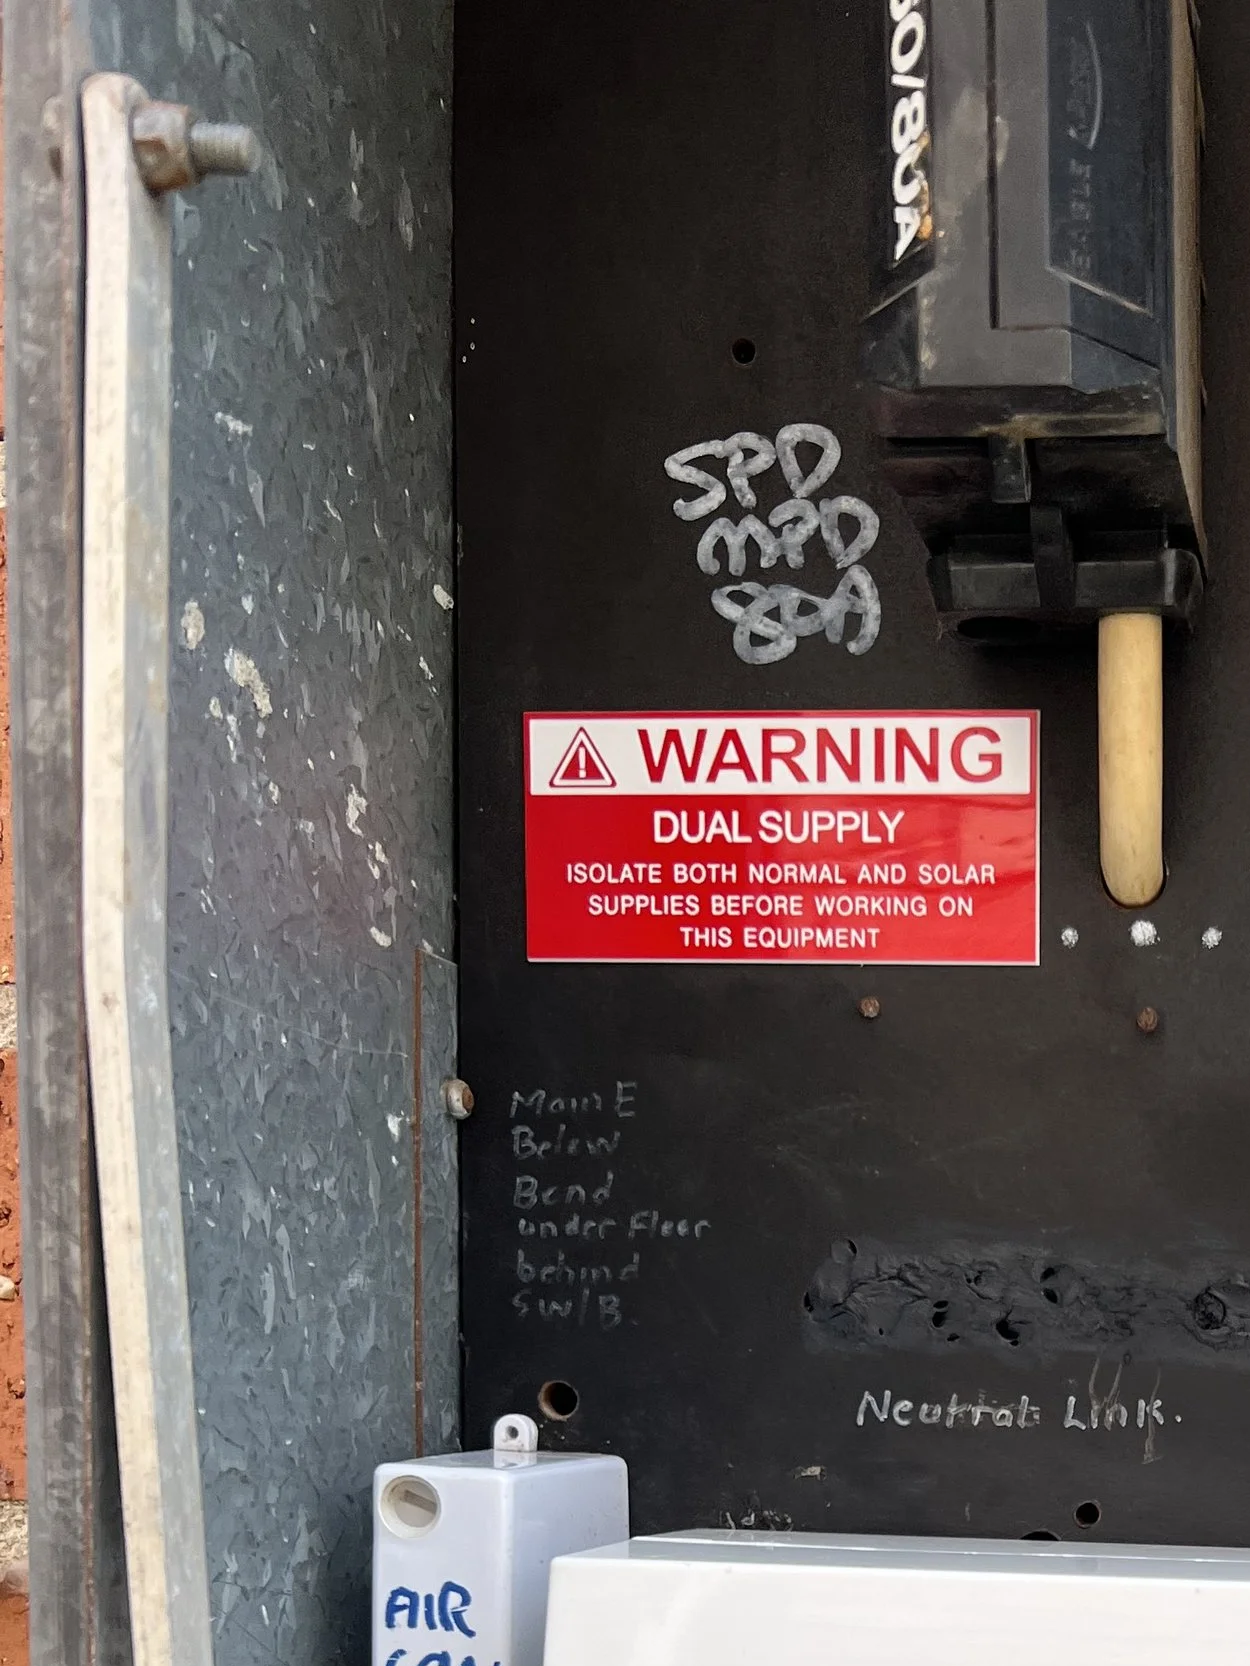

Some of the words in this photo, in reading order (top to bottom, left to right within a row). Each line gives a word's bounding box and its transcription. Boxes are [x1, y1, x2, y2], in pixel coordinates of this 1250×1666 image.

[888, 0, 928, 260] 0/80A
[664, 423, 841, 521] SPD
[637, 726, 1003, 783] WARNING
[653, 810, 752, 844] DUAL
[758, 810, 905, 844] SUPPLY
[567, 863, 661, 885] ISOLATE
[673, 863, 737, 885] BOTH
[748, 863, 846, 886] NORMAL
[857, 863, 907, 886] AND
[918, 863, 996, 886] SOLAR
[588, 895, 700, 917] SUPPLIES
[711, 895, 803, 917] BEFORE
[814, 895, 928, 917] WORKING
[939, 895, 974, 917] ON
[680, 927, 733, 949] THIS
[743, 927, 880, 949] EQUIPMENT
[385, 1580, 477, 1638] AIR
